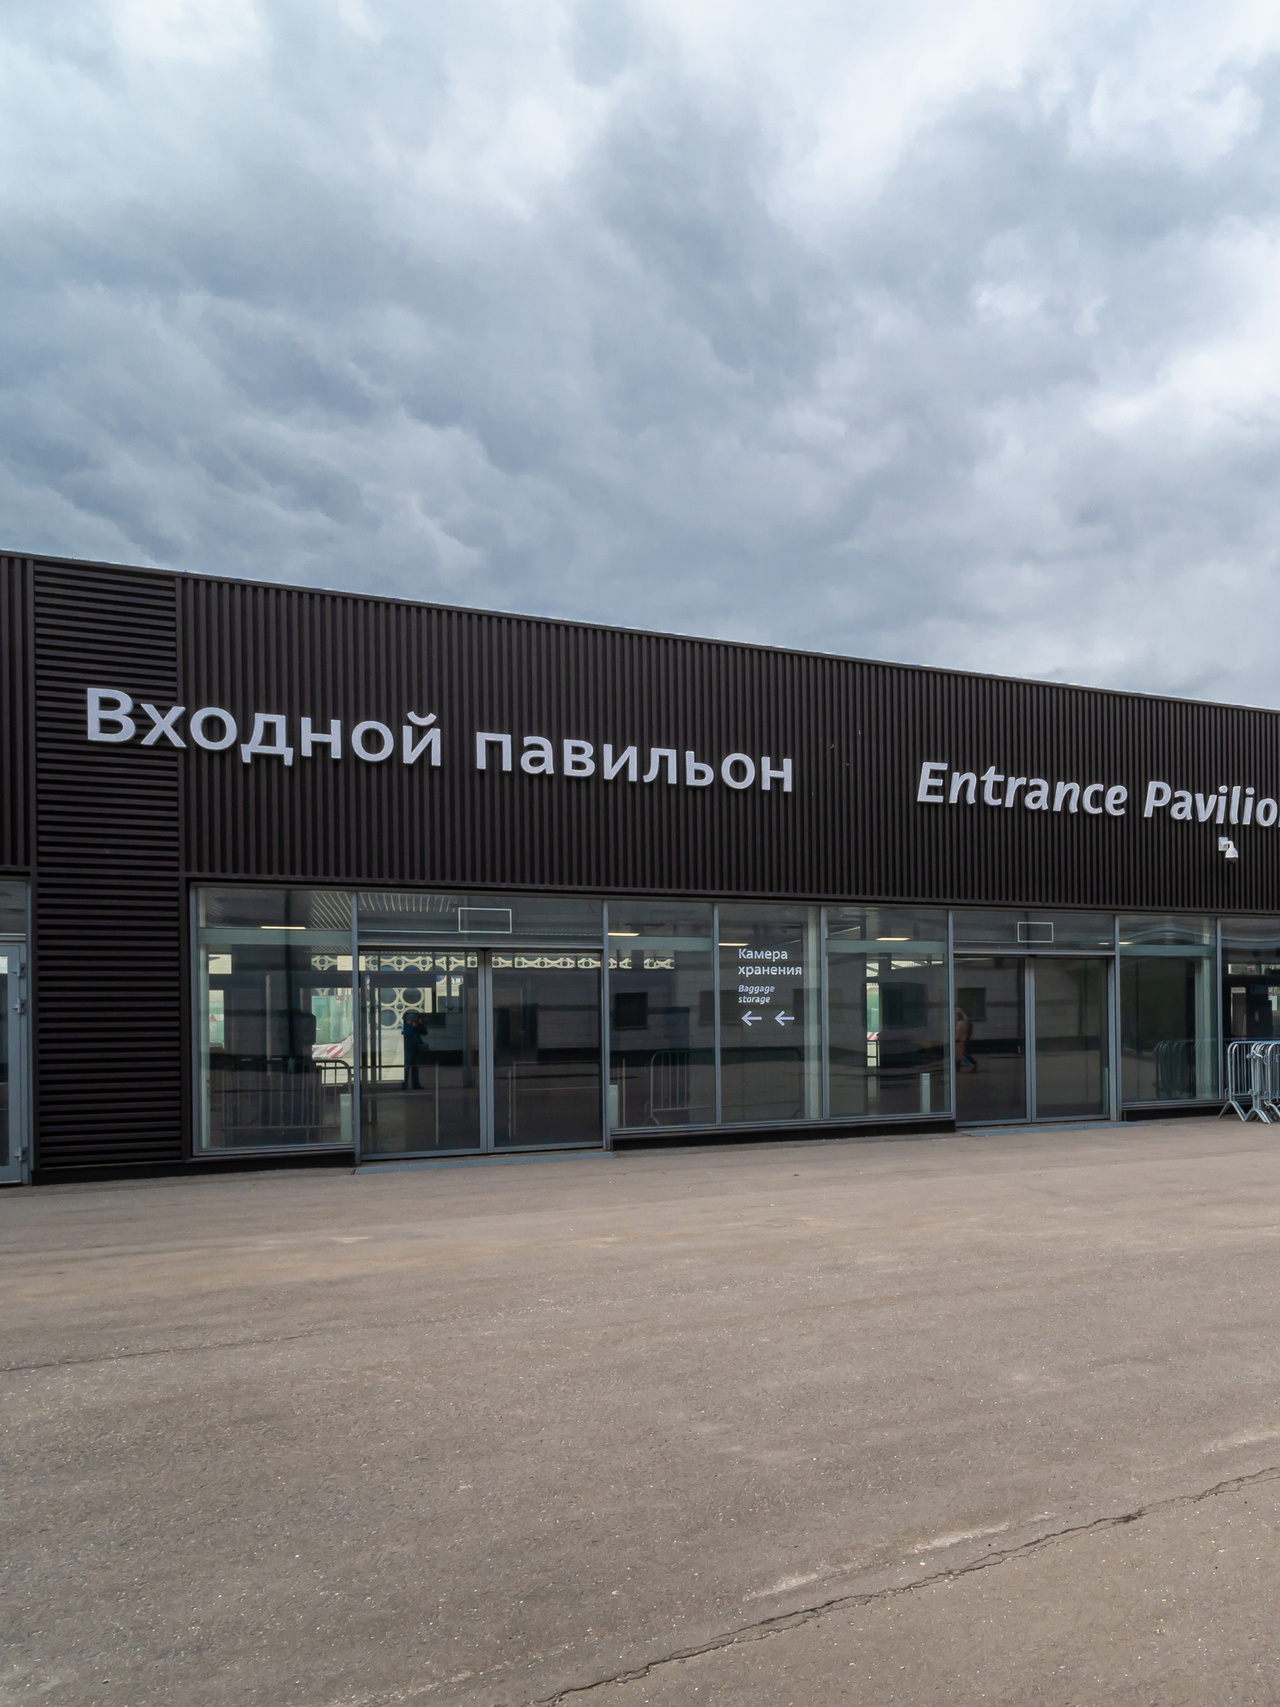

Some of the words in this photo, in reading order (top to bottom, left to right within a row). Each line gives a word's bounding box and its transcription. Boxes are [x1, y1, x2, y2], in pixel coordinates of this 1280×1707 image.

[86, 687, 443, 768] Входной
[475, 730, 794, 793] павильон
[916, 761, 1129, 817] Entrance
[738, 948, 789, 962] Камера
[738, 965, 803, 978] хранения
[738, 984, 775, 994] Baggage
[738, 995, 771, 1005] storage
